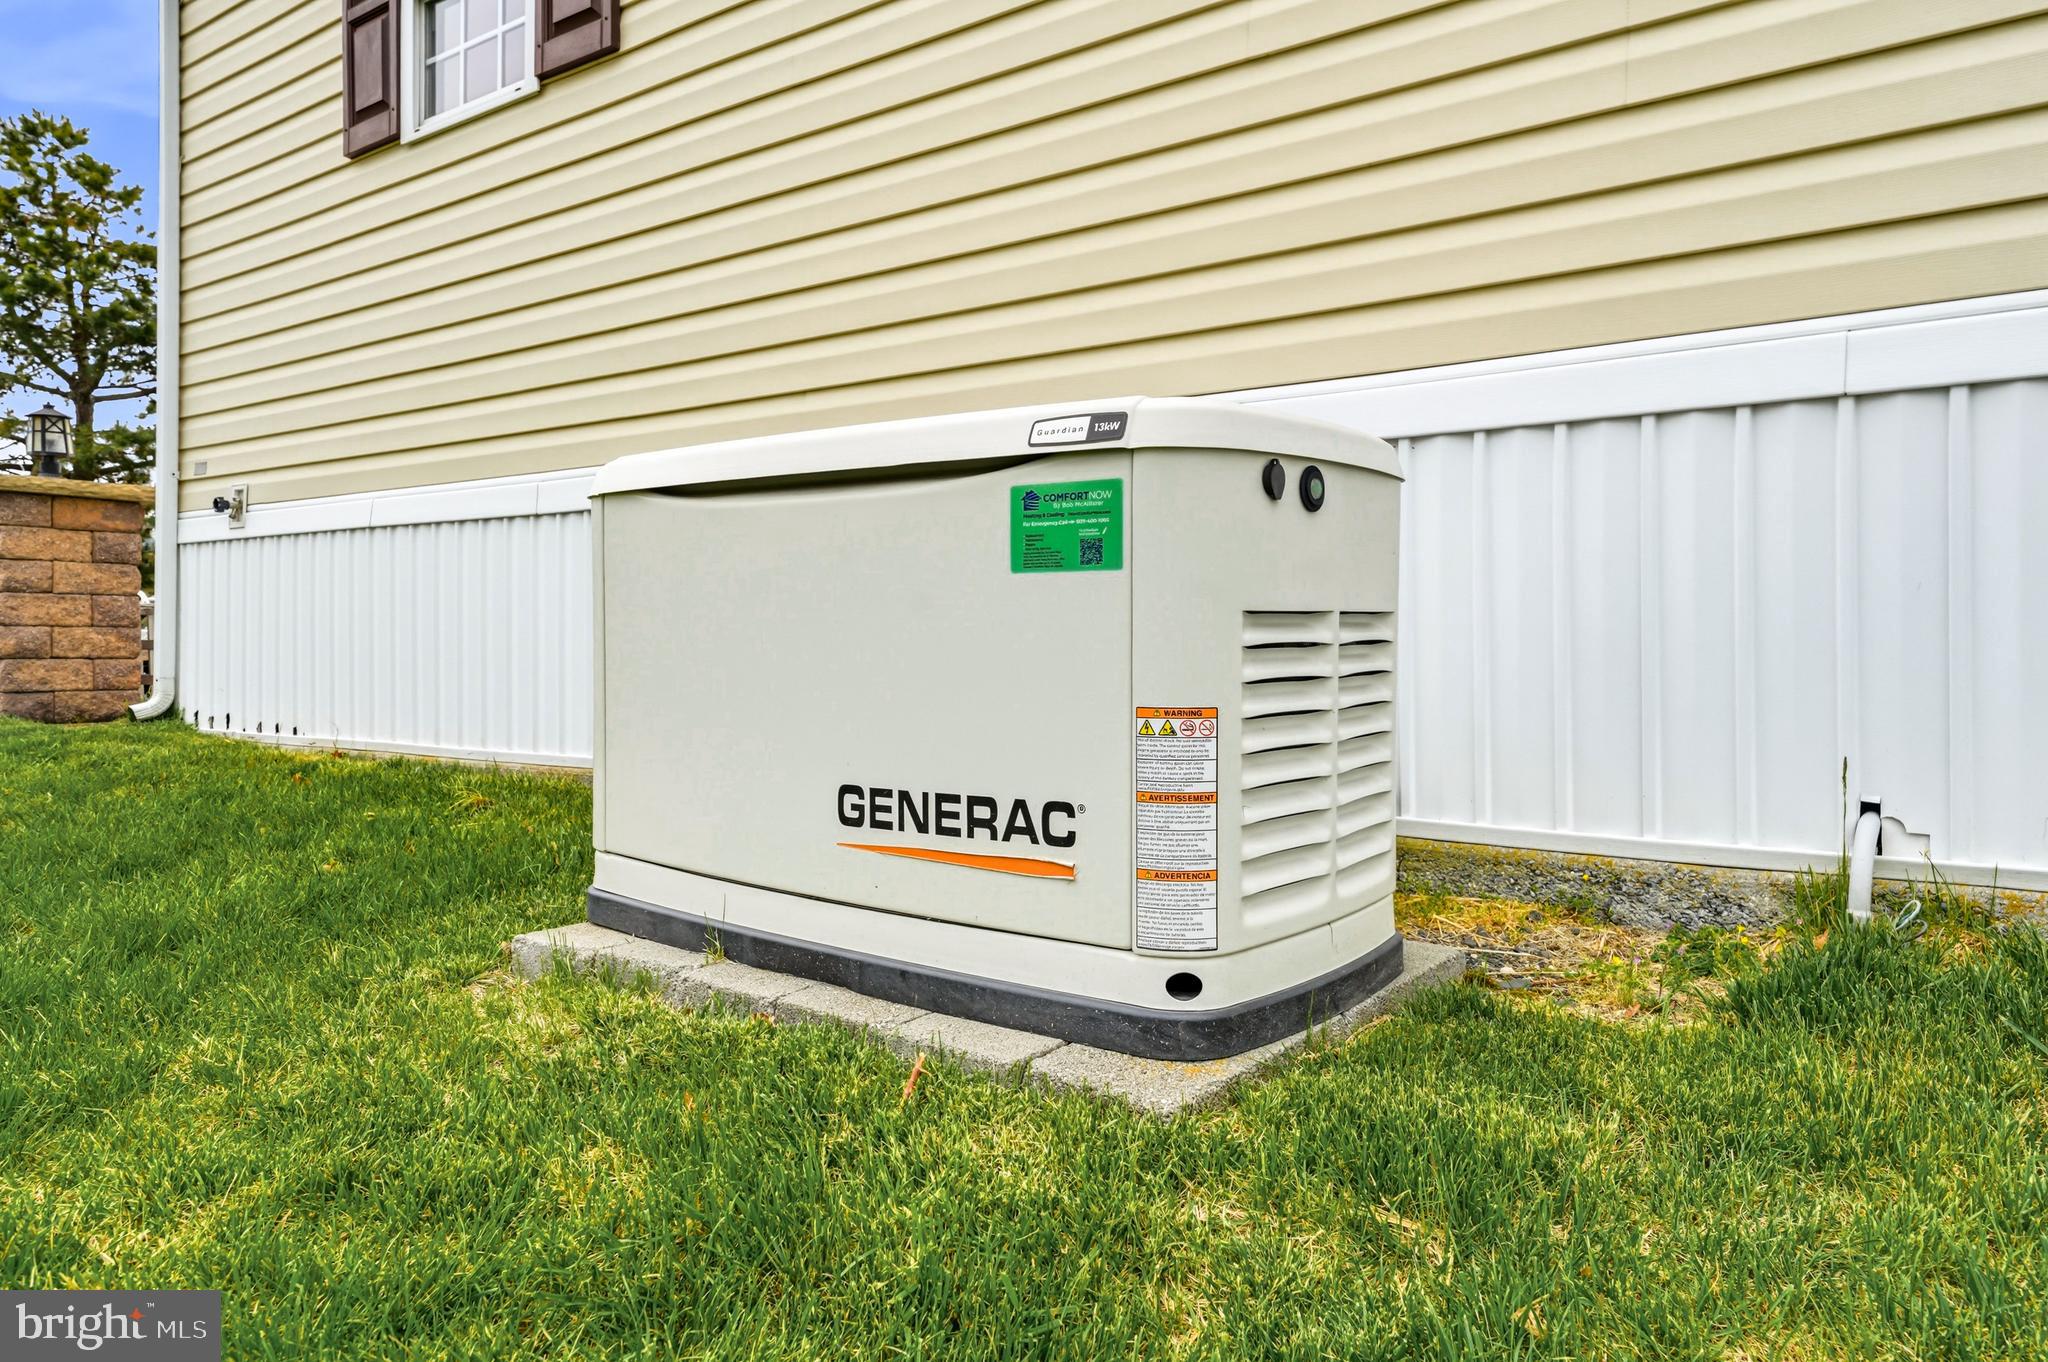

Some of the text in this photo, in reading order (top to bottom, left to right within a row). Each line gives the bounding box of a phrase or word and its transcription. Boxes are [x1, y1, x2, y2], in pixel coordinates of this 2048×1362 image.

[1036, 421, 1121, 437] Guardian 13kW
[1043, 489, 1113, 503] COMFORTNOW
[1164, 709, 1203, 717] WARNING
[1148, 794, 1215, 802] AVERTISSEMENT
[837, 784, 1077, 848] GENERAC
[1154, 872, 1211, 880] ADVERTENCIA
